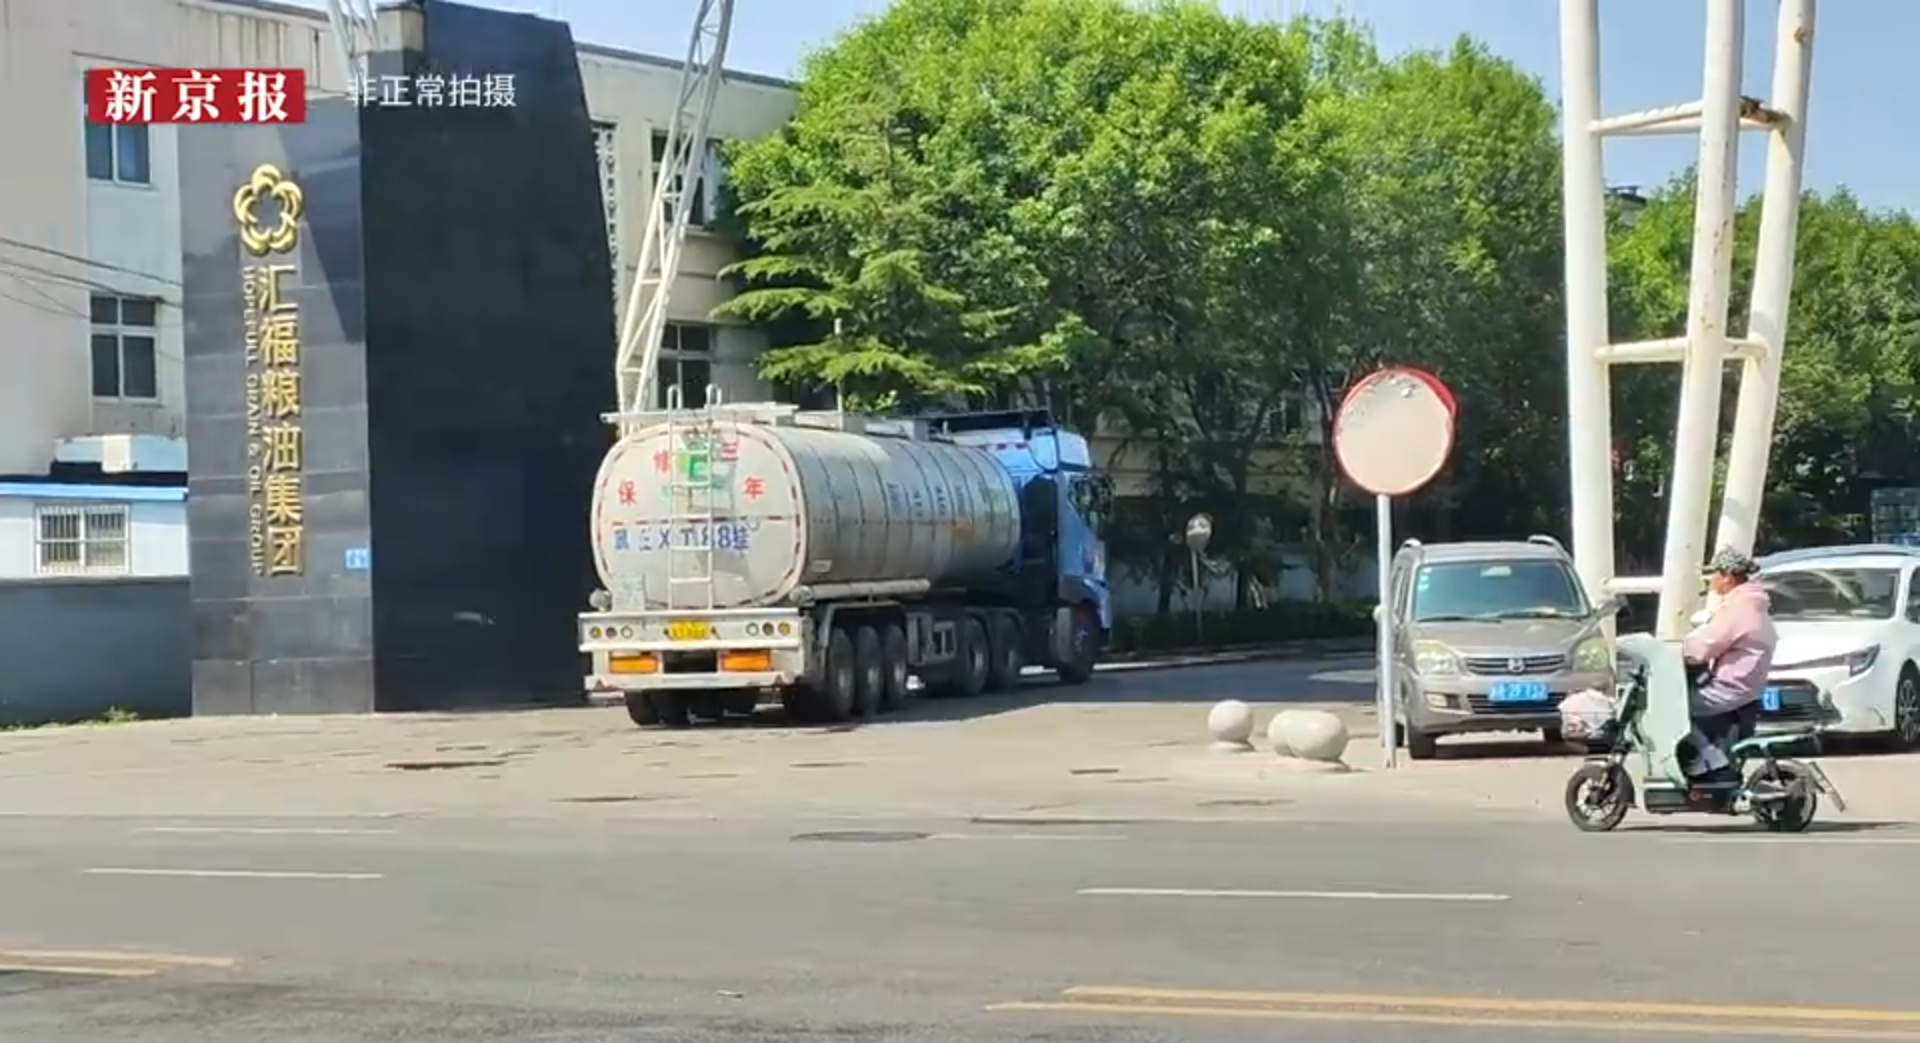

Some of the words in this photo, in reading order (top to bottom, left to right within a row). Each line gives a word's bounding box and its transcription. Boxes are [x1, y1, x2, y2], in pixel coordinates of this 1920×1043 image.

[243, 265, 258, 368] HOPEFULL
[246, 374, 261, 435] GRAIN
[258, 264, 303, 575] 汇福粮油集团
[249, 465, 262, 498] OIL
[250, 503, 265, 577] GROUP
